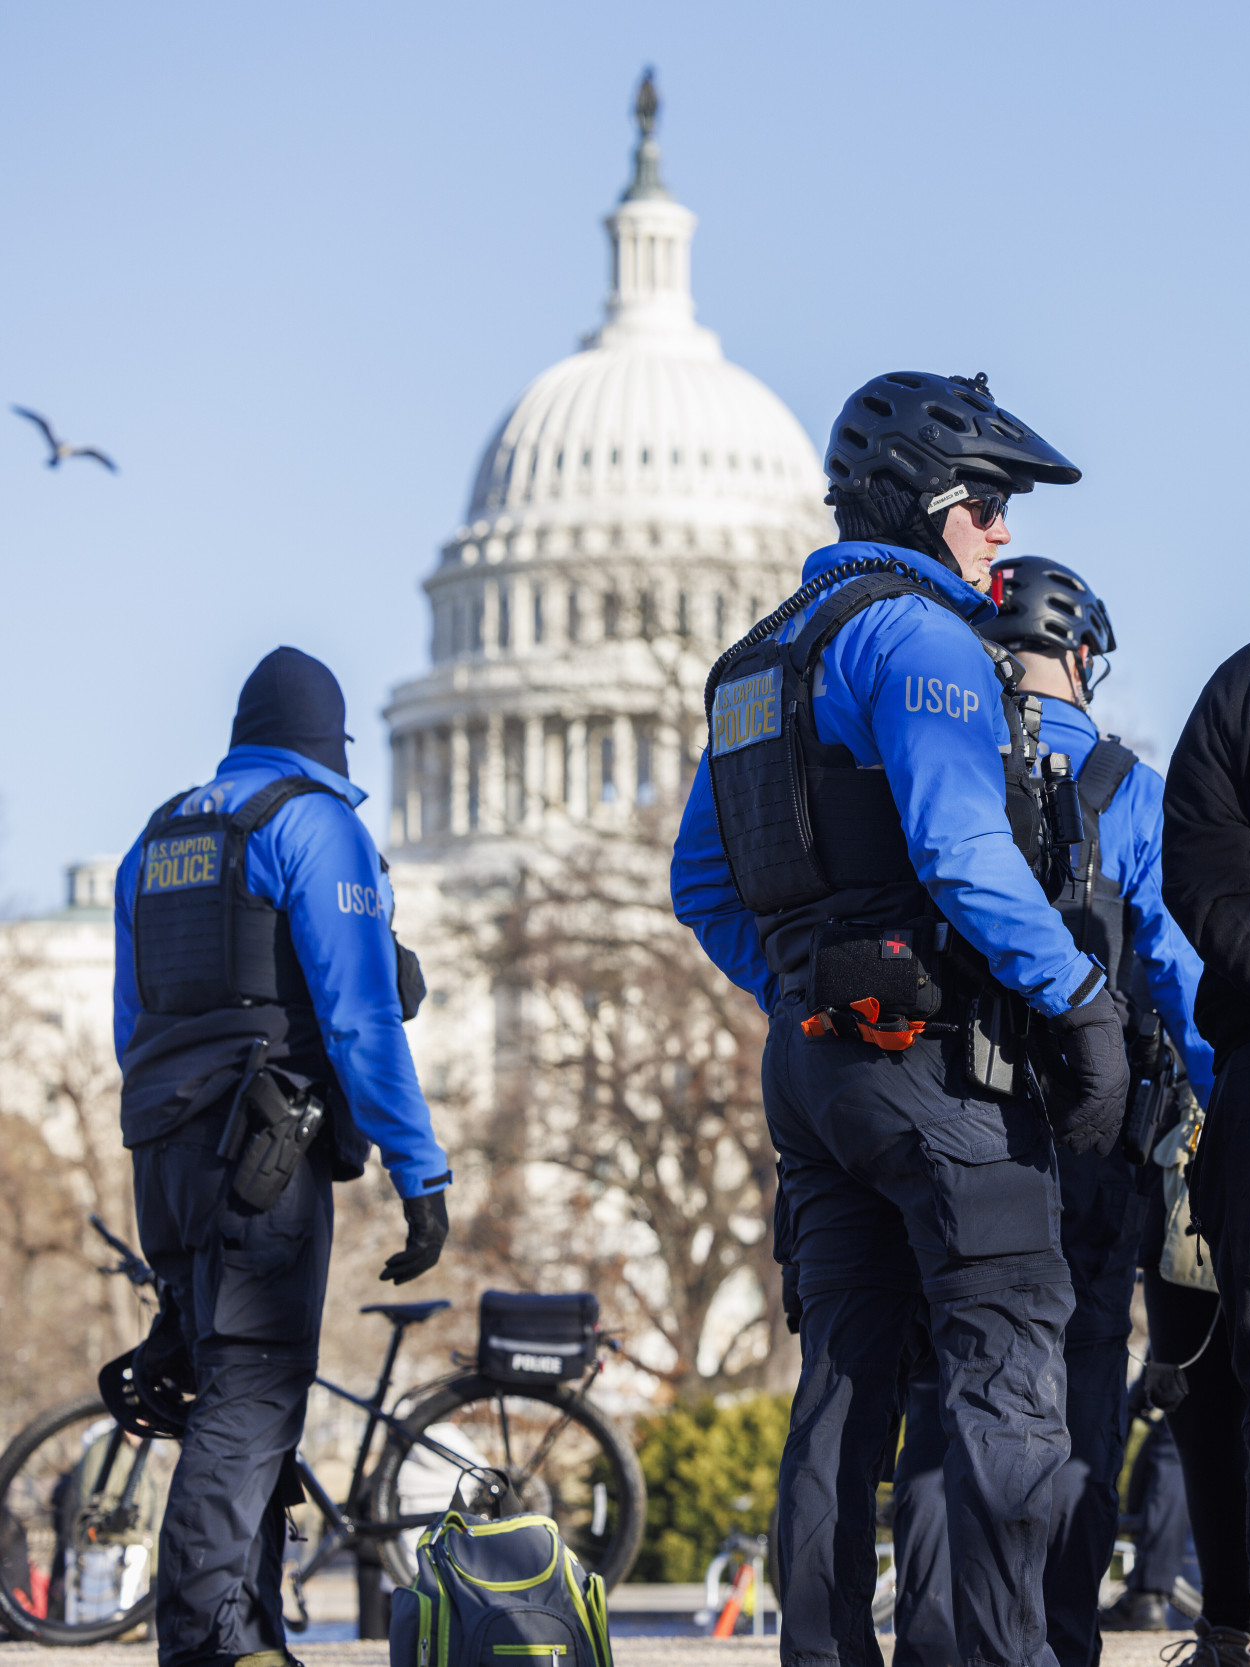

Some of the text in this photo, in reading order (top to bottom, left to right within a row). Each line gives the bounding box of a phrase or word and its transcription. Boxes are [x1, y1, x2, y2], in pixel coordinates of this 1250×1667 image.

[715, 674, 776, 711] U.S. CAPITOL
[905, 676, 979, 723] USCP
[715, 696, 776, 750] POLICE
[150, 839, 218, 861] U.S. CAPITOL
[146, 856, 215, 890] POLICE
[512, 1353, 563, 1374] POLICE
